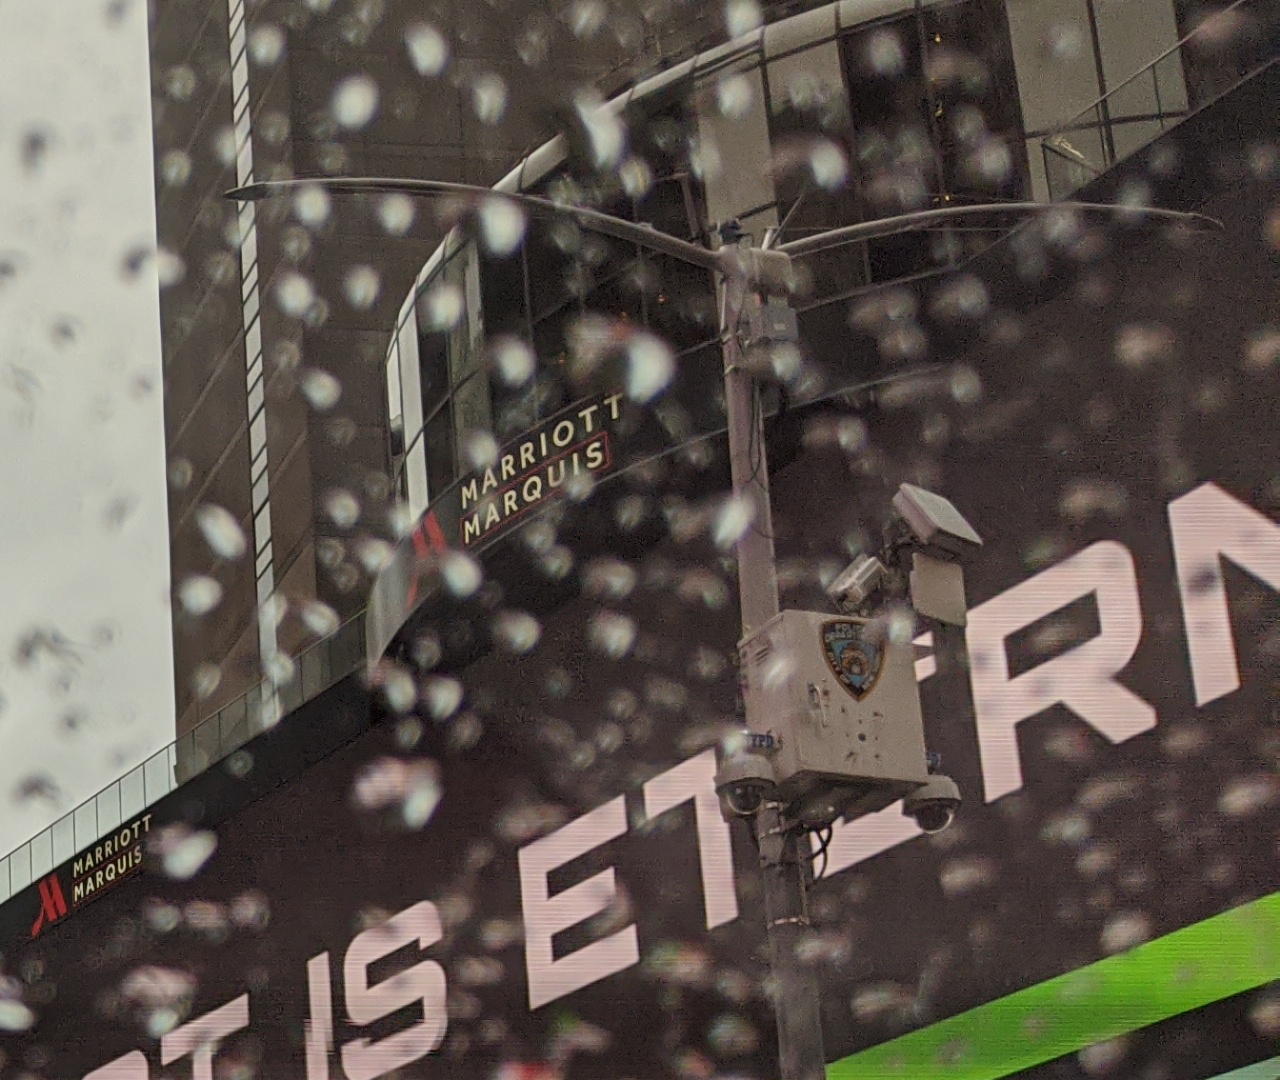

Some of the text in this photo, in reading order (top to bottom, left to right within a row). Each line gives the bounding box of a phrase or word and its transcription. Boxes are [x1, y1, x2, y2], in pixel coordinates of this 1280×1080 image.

[461, 393, 624, 510] MARRIOTT
[463, 441, 604, 544] MARQUIS
[72, 813, 152, 879] MARRIOTT
[73, 844, 143, 903] MARQUIS
